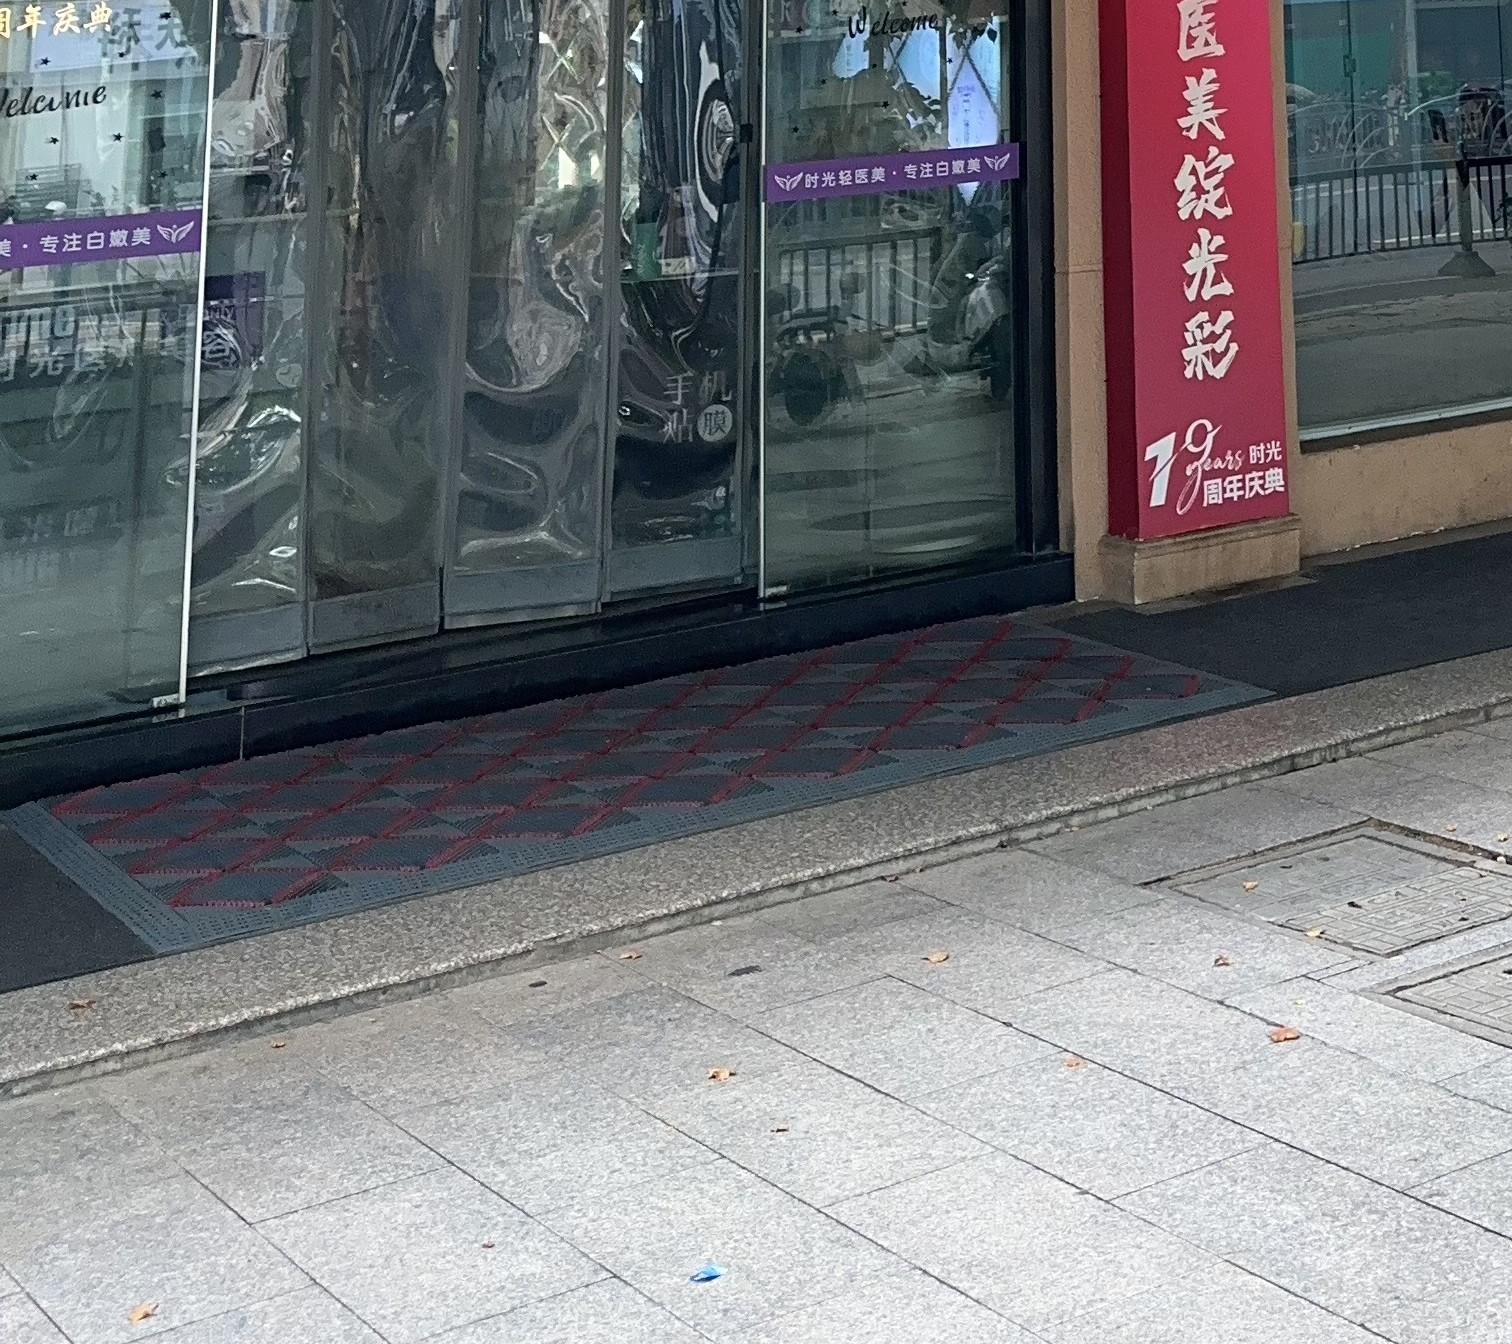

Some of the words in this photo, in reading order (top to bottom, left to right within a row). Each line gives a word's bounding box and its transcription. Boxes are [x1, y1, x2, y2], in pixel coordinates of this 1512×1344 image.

[847, 6, 940, 39] Welcome
[1249, 440, 1283, 465] 时光
[1202, 466, 1286, 508] 周年庆典
